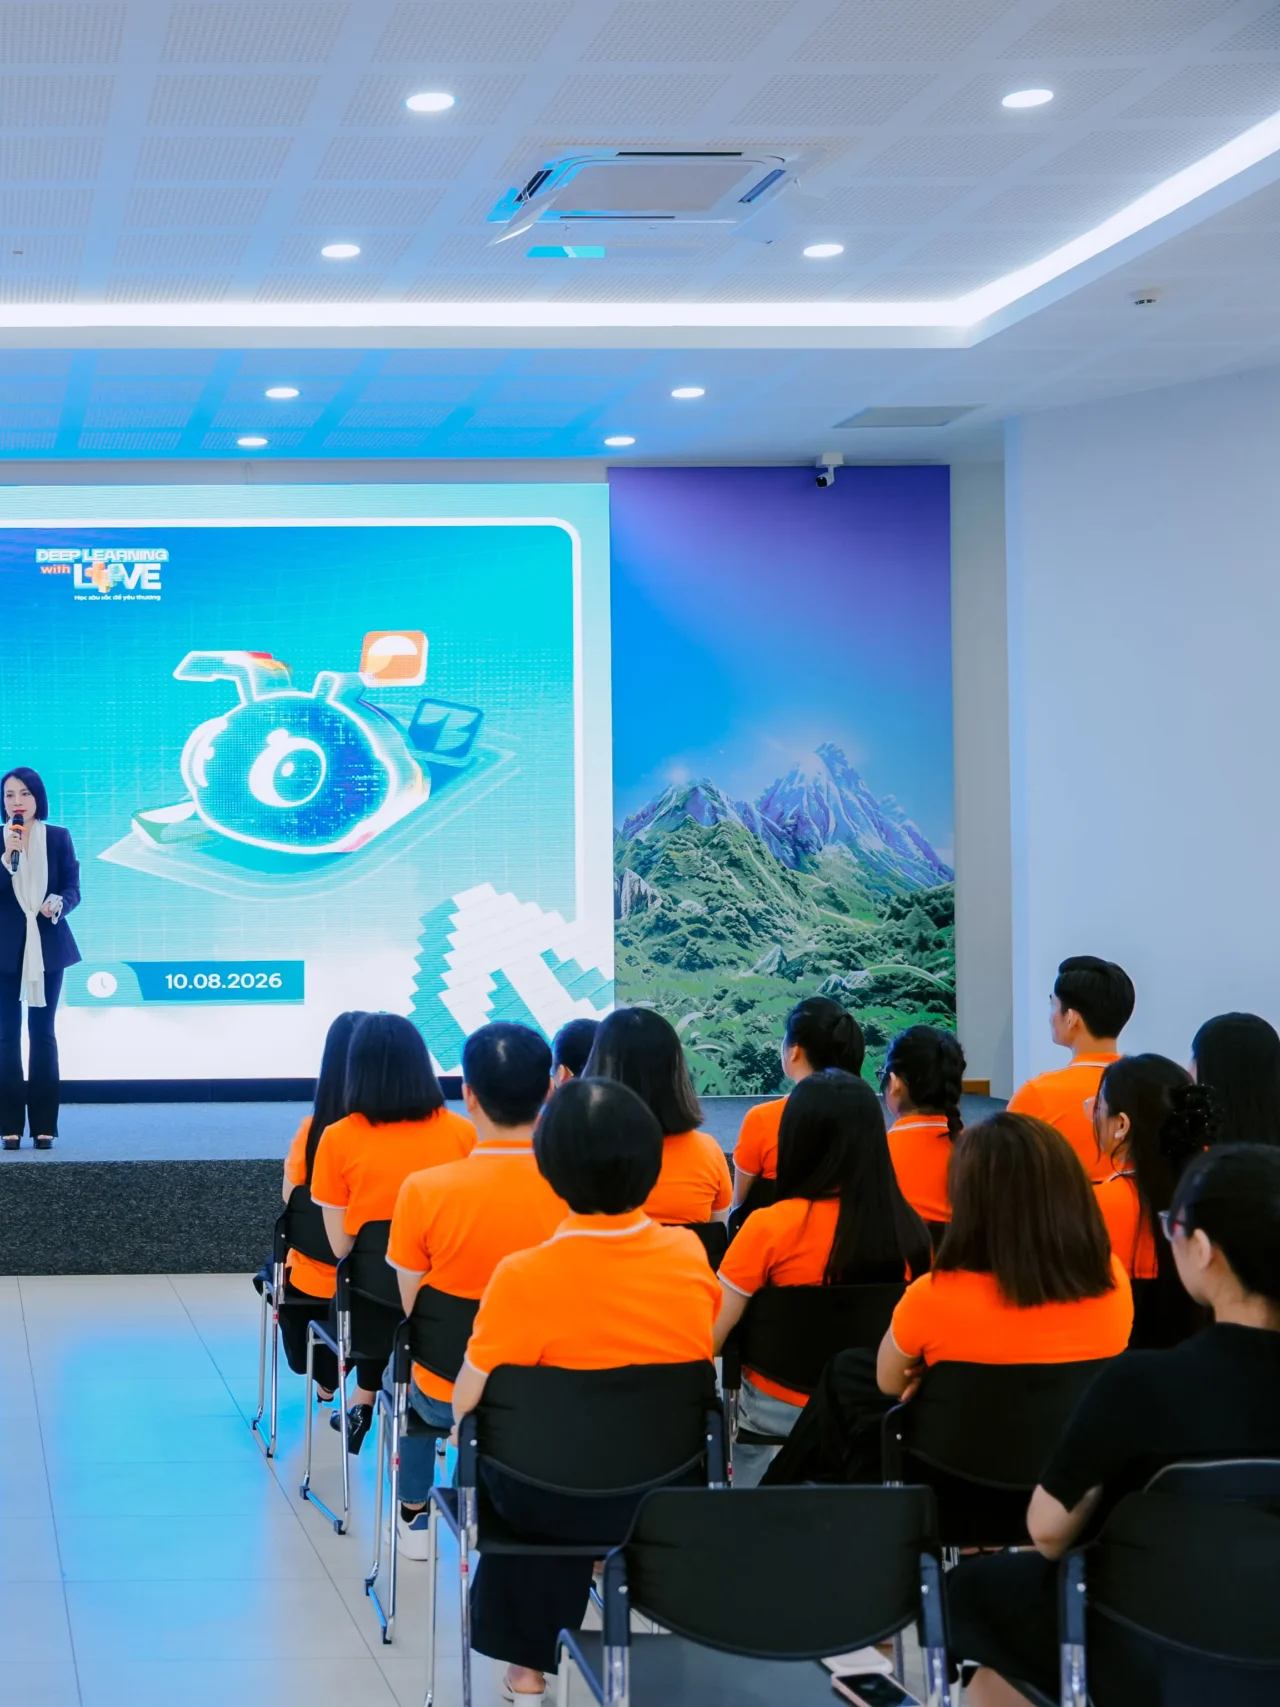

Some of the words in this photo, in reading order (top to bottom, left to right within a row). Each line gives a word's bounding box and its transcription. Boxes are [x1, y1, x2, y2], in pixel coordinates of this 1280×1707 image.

[36, 549, 80, 563] DEEP
[82, 548, 169, 562] LEARNING
[41, 564, 71, 574] with
[164, 972, 283, 990] 10.08.2026
